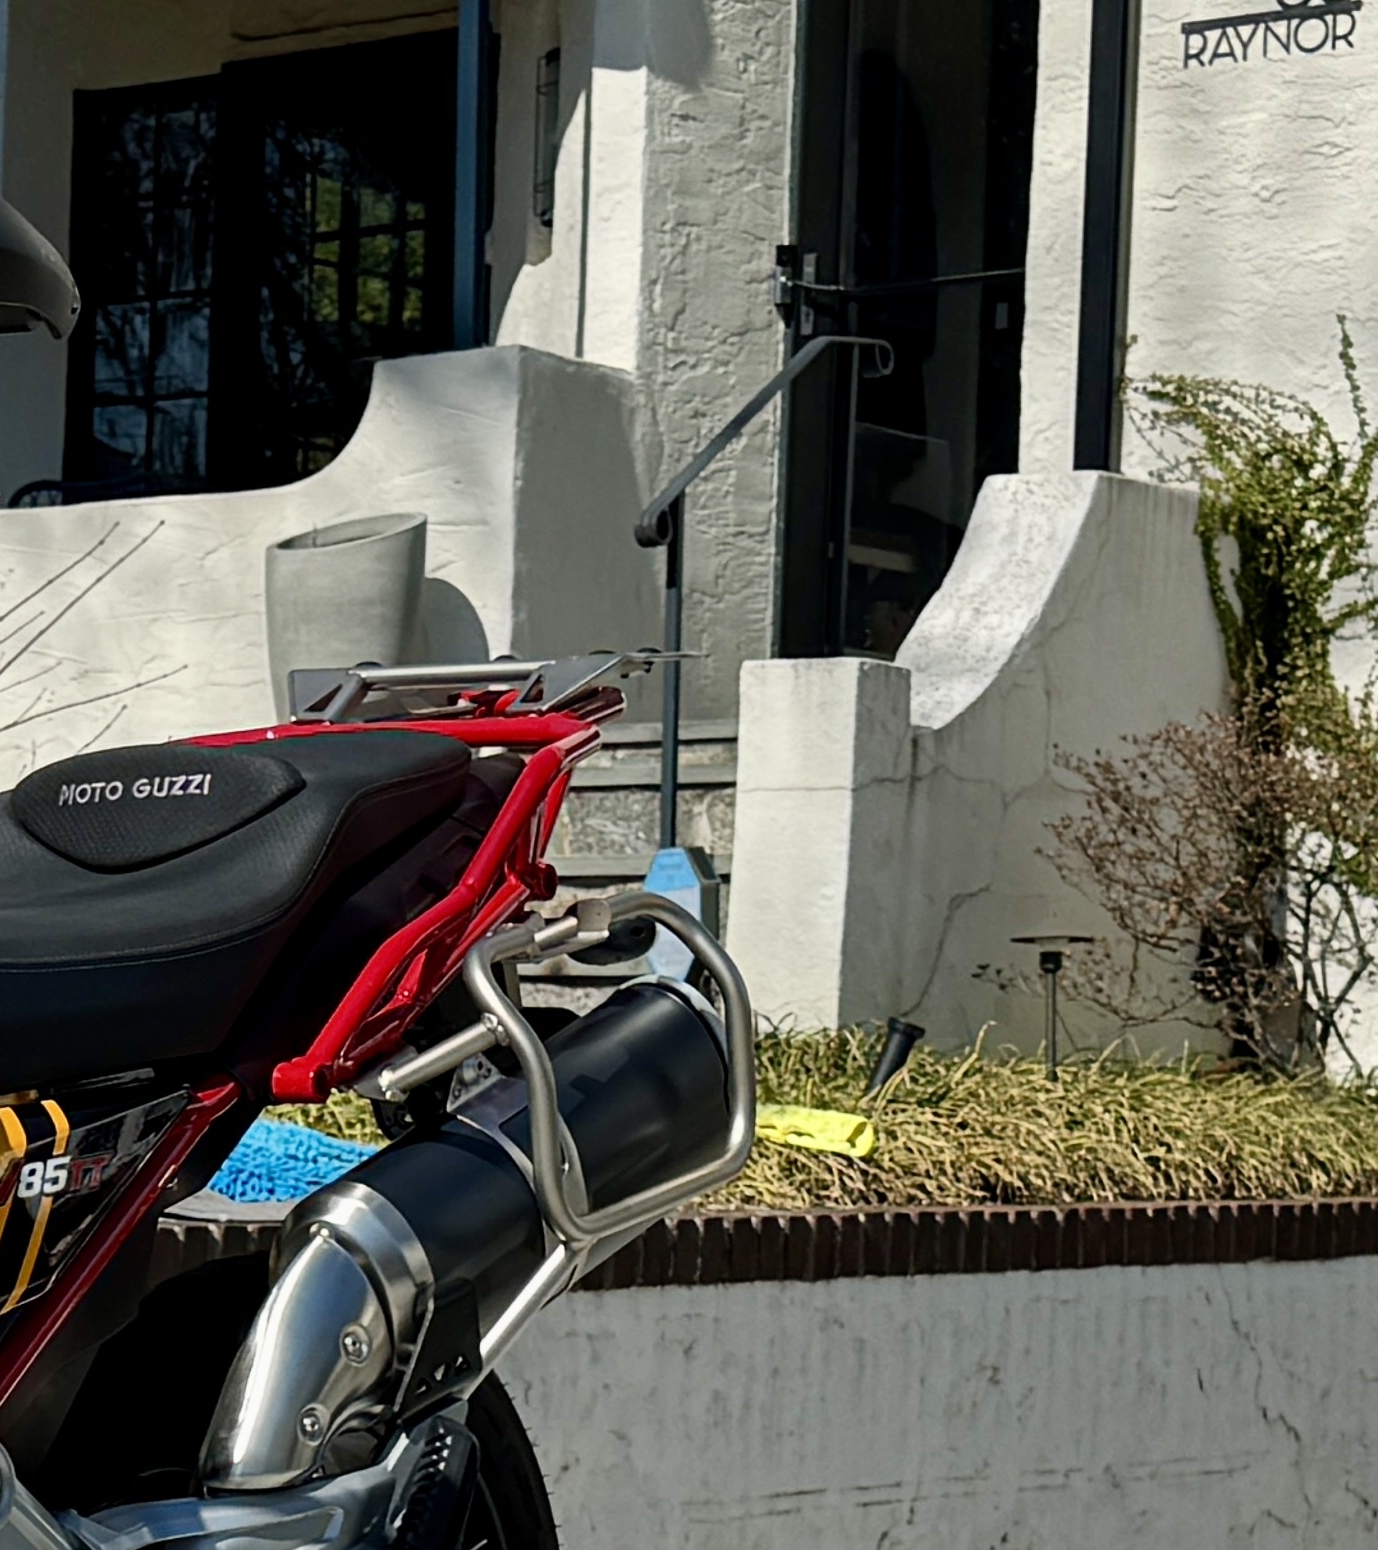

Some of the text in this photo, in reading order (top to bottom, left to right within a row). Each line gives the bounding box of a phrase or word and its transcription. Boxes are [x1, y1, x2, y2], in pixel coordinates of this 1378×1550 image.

[1181, 12, 1356, 69] RAYNOR
[59, 773, 212, 806] MOTO GUZZI
